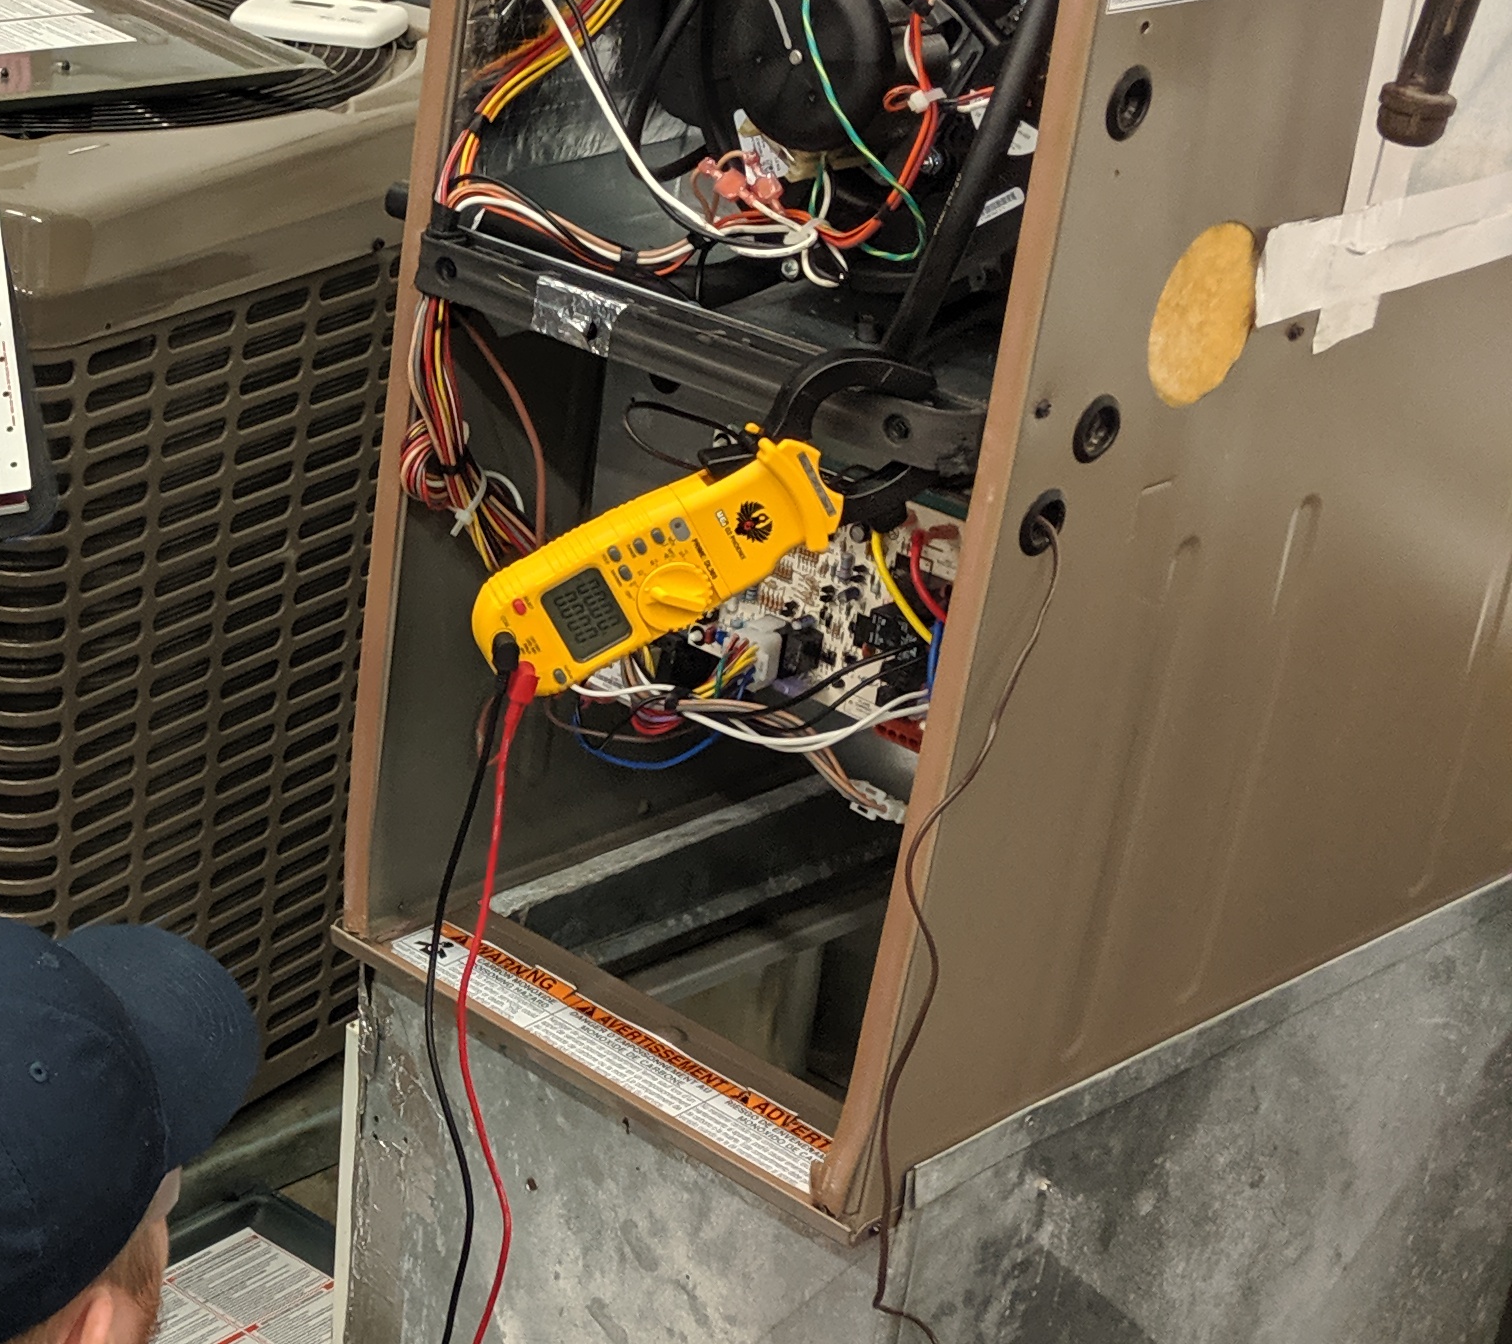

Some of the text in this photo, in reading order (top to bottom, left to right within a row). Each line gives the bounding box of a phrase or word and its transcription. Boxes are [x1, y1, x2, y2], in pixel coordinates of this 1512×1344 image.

[476, 941, 558, 993] WARNNG
[476, 957, 557, 1005] CARBON MONOXIDE
[513, 985, 550, 1009] HAZARD
[568, 1009, 607, 1035] DANGER
[695, 1082, 712, 1095] AU
[579, 1024, 686, 1089] MONOXIDE DE CARBONE
[596, 1011, 727, 1092] AVERTISSEMENT
[724, 1098, 758, 1122] RIESGO
[757, 1117, 771, 1129] DE
[784, 1142, 799, 1154] DE
